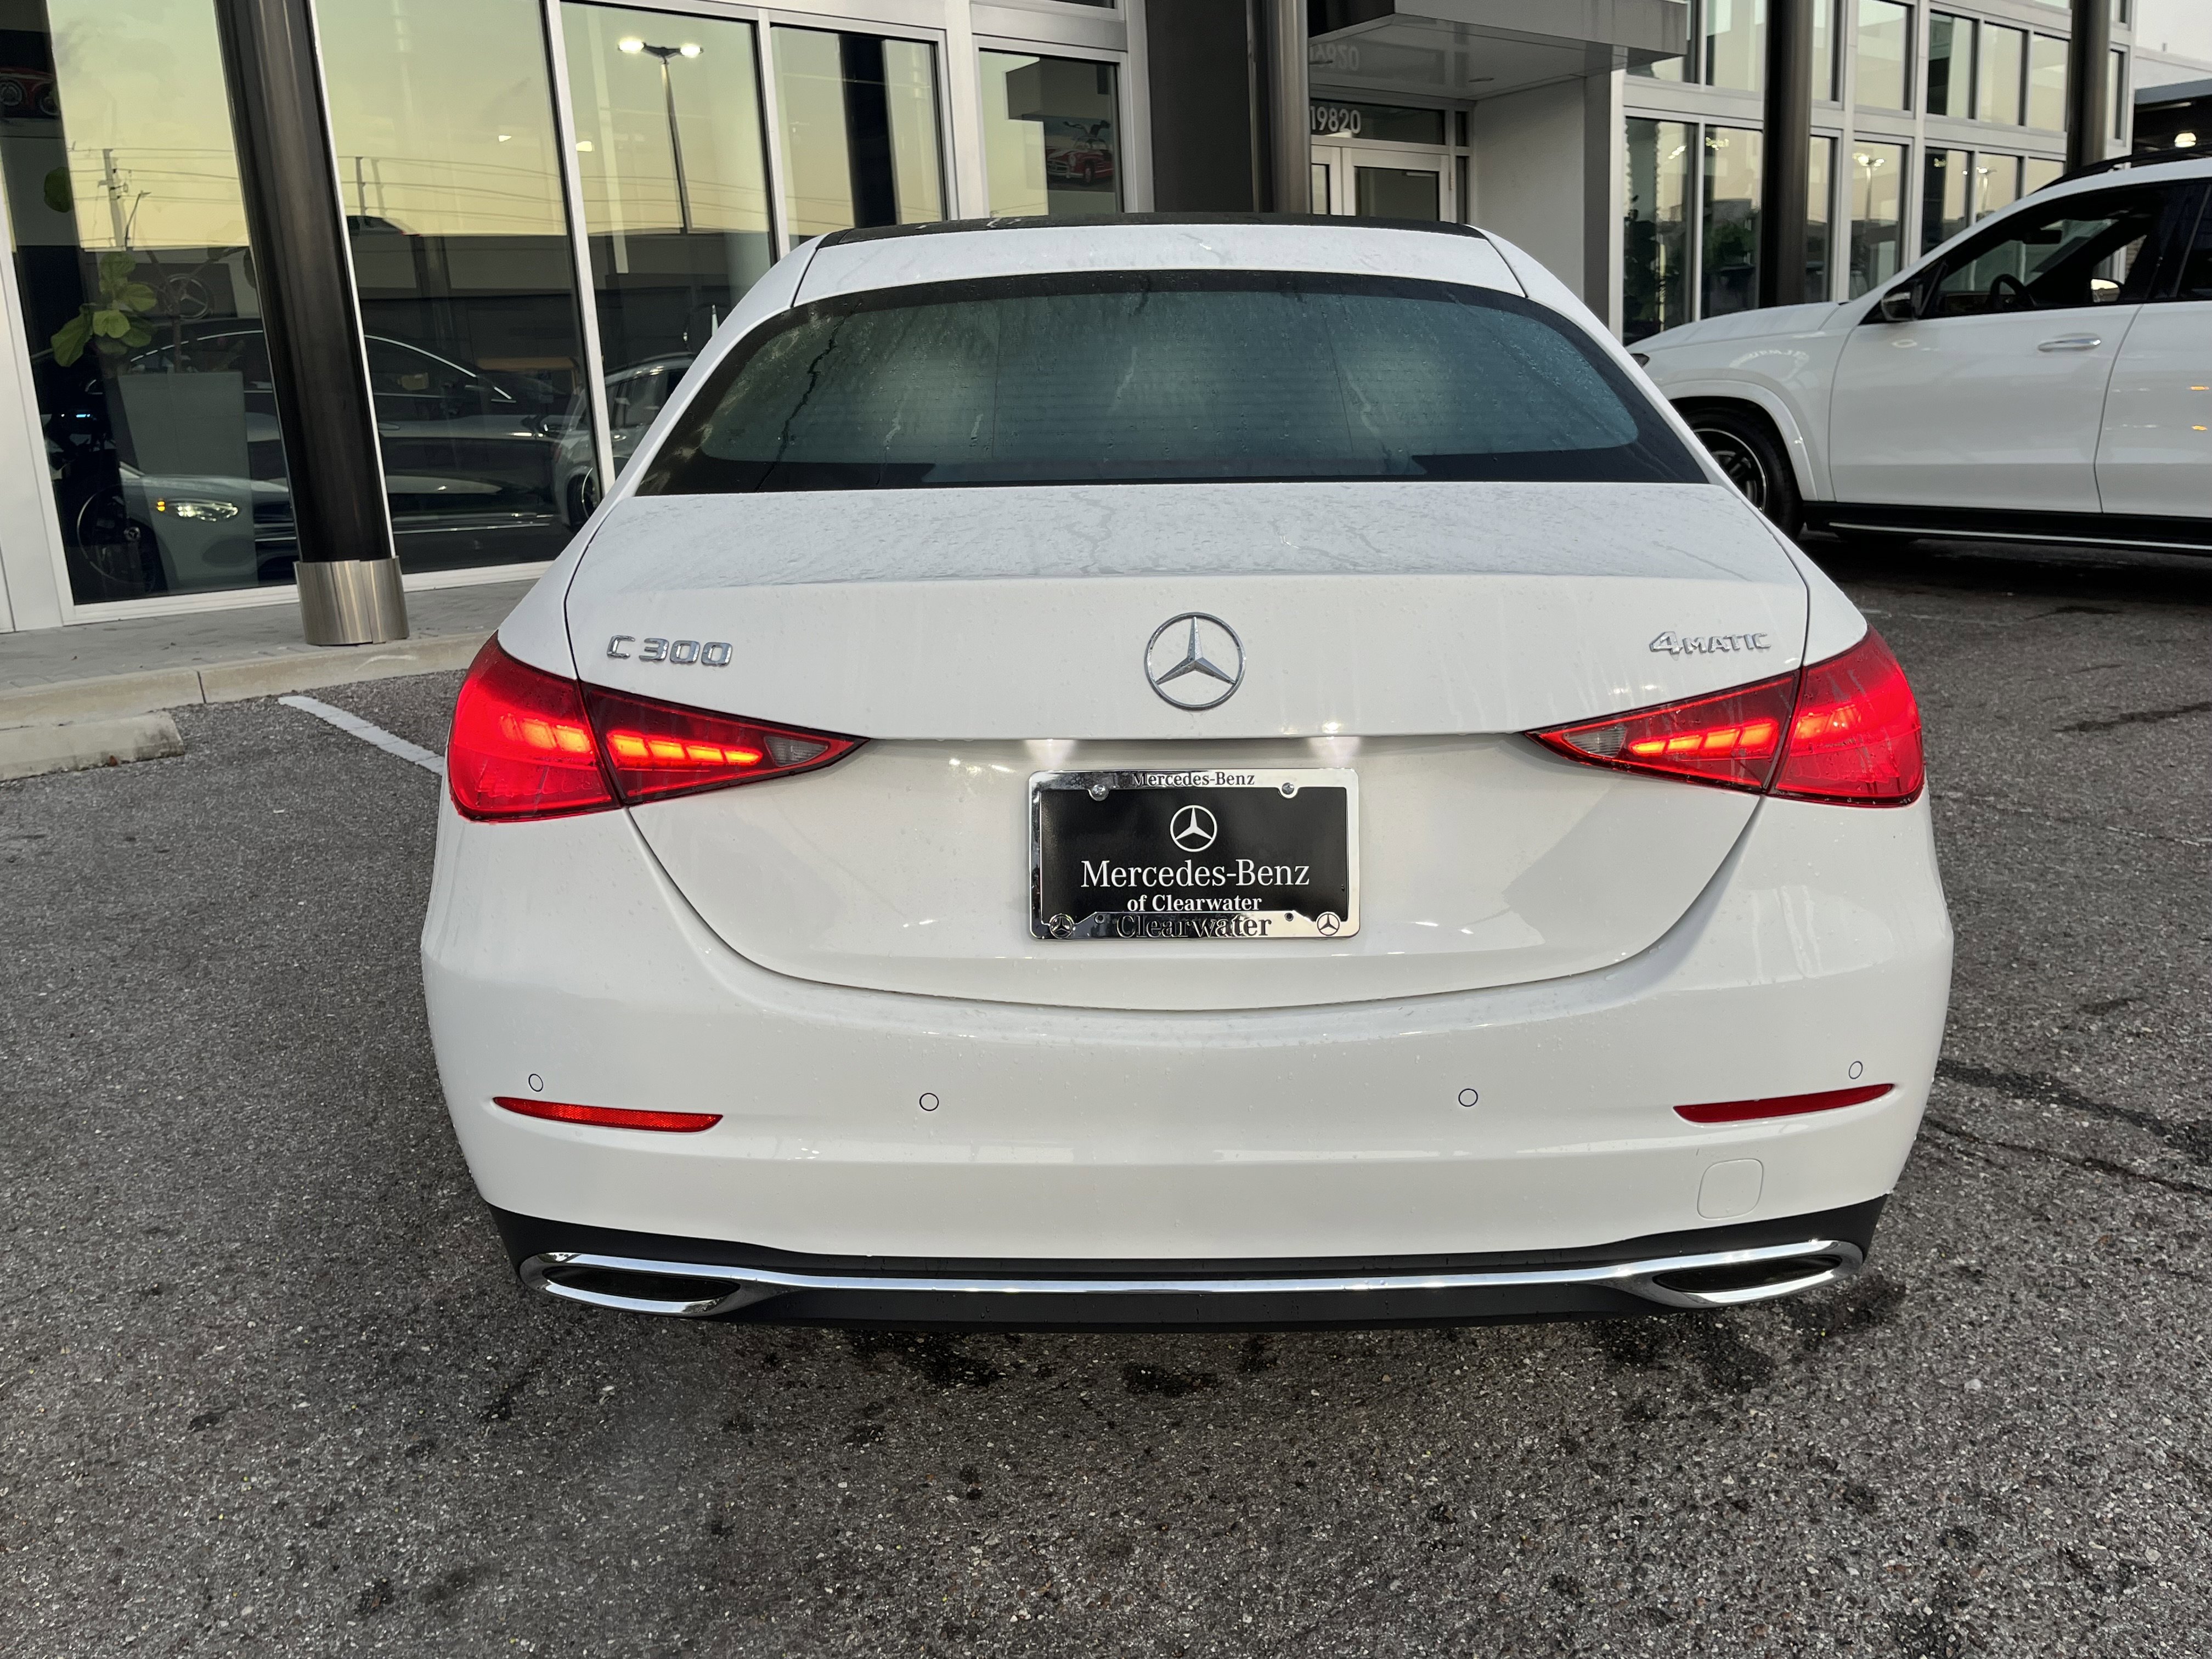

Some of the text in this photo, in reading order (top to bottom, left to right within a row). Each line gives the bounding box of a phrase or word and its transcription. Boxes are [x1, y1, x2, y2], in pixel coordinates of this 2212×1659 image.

[1310, 106, 1361, 134] 19820
[607, 635, 733, 667] C 300
[1649, 631, 1771, 654] 4MATIC
[1131, 772, 1255, 786] Mercedes-Benz
[1081, 859, 1310, 888] Mercedes-Benz
[1127, 894, 1262, 911] of Clearwater
[1116, 915, 1272, 938] Clearwater
